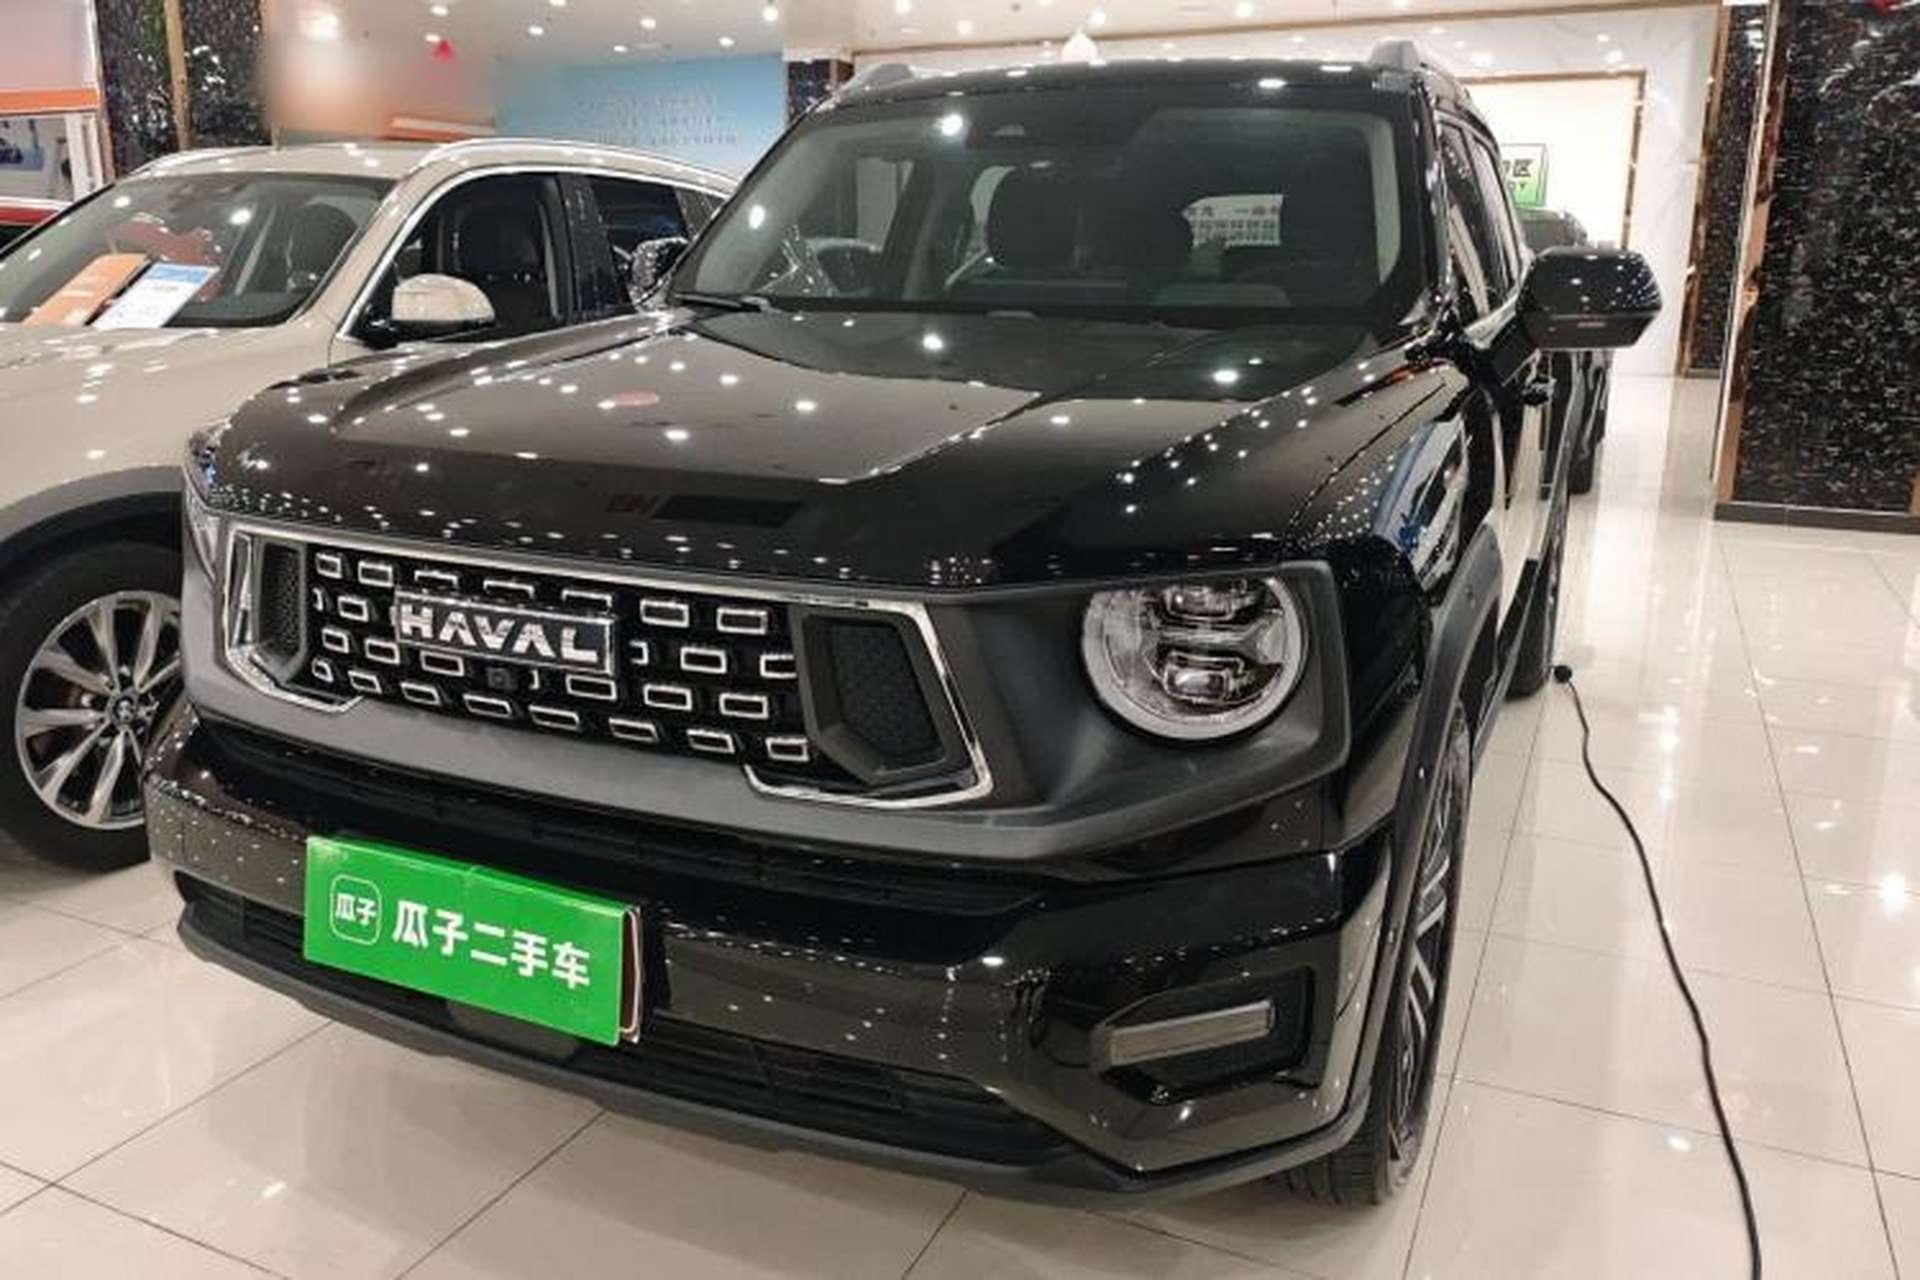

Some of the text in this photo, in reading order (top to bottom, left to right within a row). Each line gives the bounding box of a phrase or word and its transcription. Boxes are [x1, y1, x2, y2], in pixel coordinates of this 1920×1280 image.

[400, 603, 599, 663] HAVAL
[335, 892, 377, 927] 瓜子
[392, 899, 591, 990] 瓜子二手车
